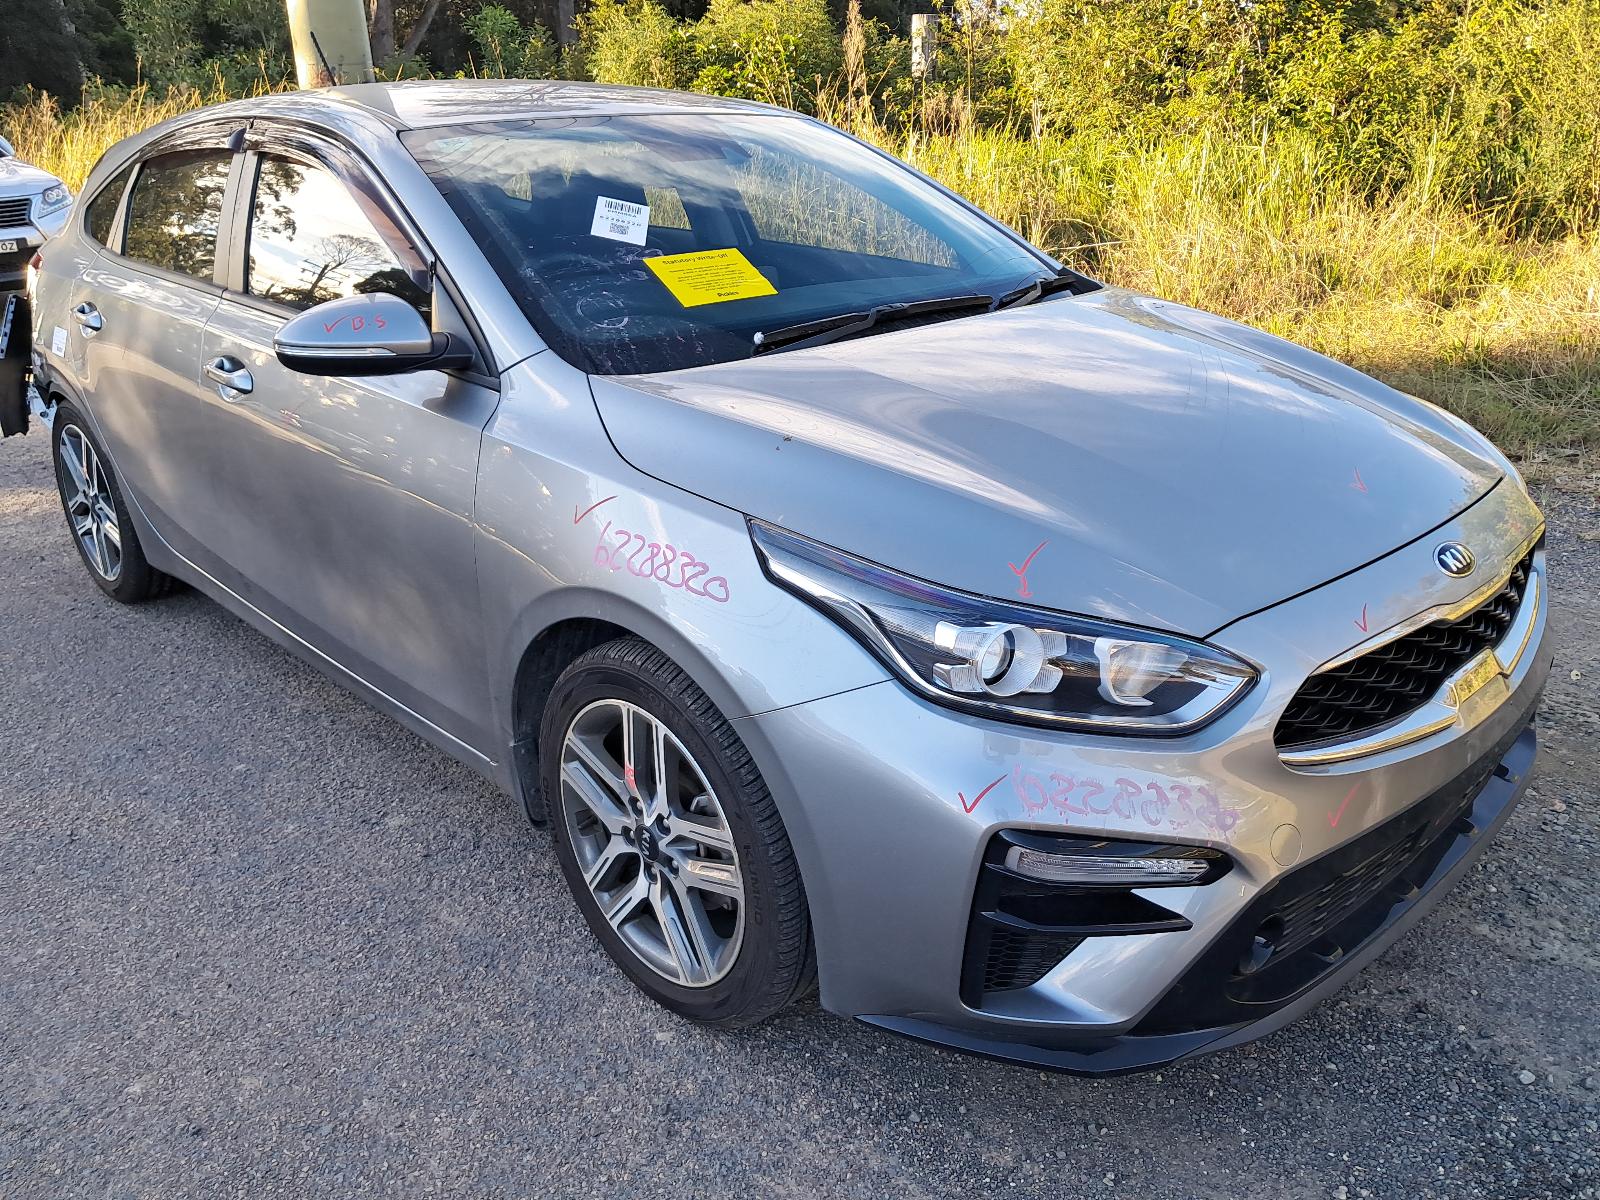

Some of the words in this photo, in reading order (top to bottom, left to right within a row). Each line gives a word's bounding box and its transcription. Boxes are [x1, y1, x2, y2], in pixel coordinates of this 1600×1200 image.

[662, 257, 696, 265] Statutory
[1439, 545, 1475, 572] KIA
[642, 829, 651, 856] KIA
